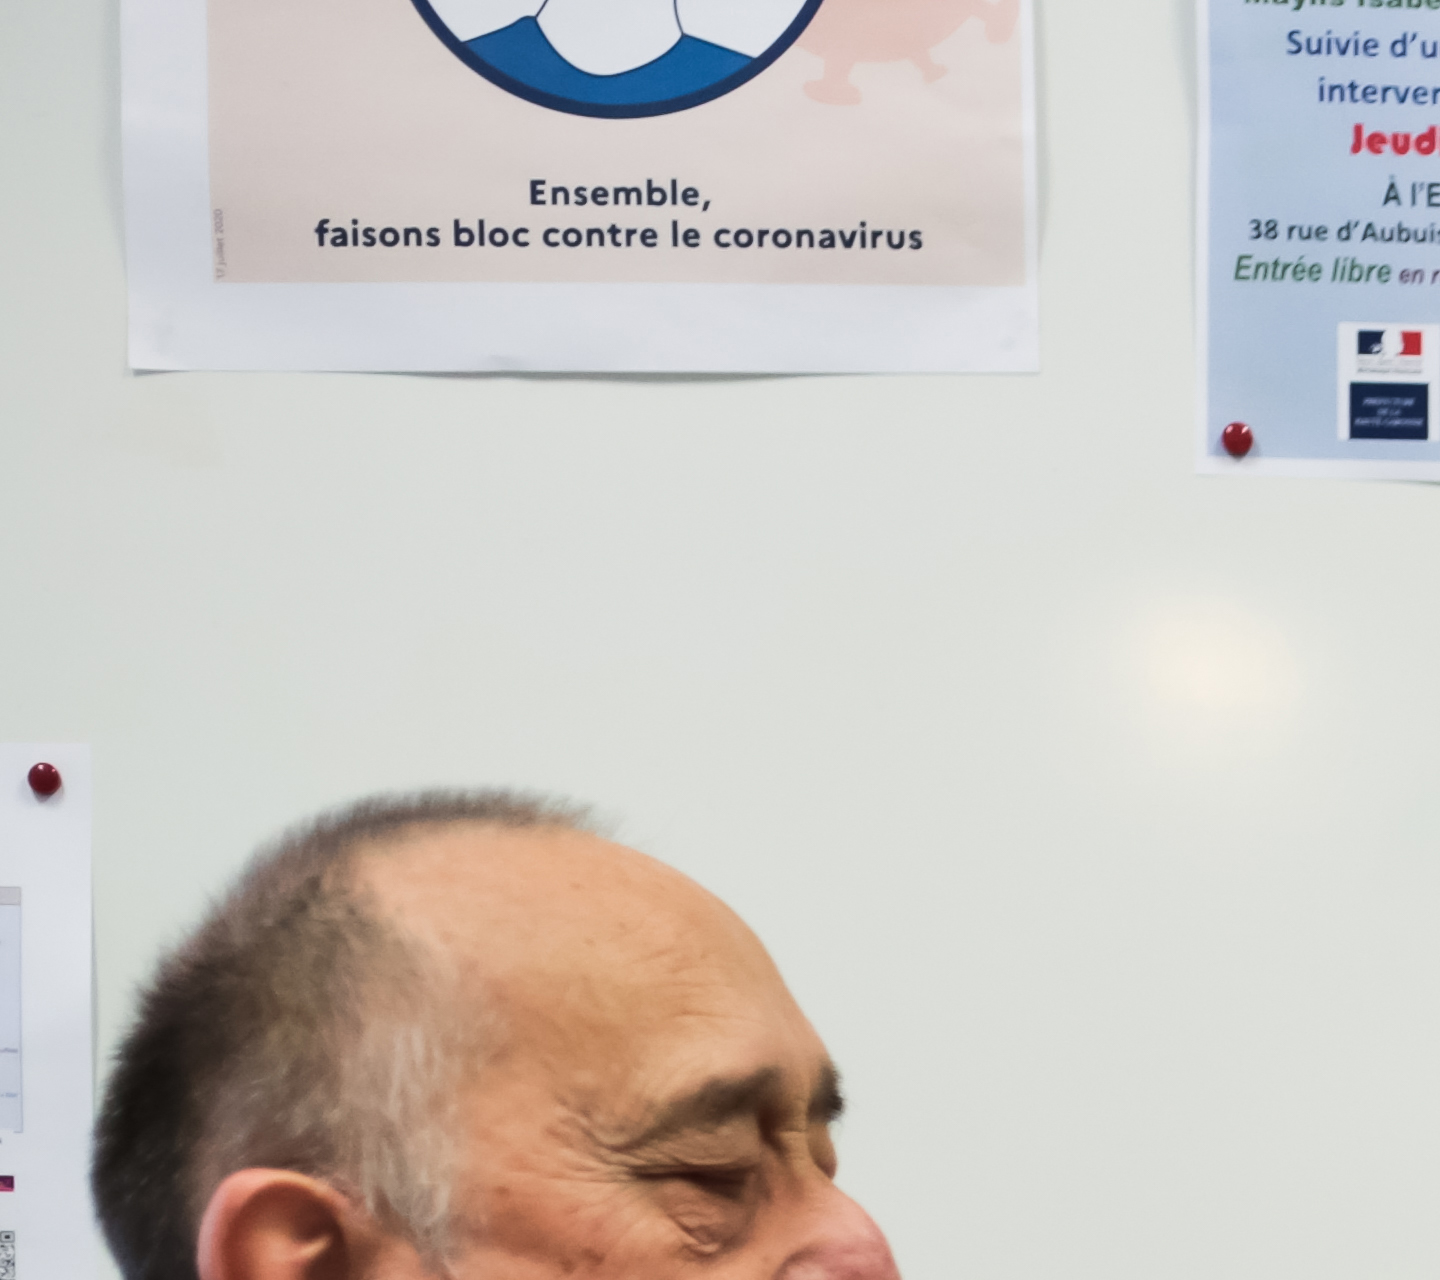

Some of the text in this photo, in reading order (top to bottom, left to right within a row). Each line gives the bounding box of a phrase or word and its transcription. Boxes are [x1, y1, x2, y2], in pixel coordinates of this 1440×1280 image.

[1286, 29, 1380, 58] Suivie
[530, 179, 711, 212] Ensemble,
[1383, 175, 1401, 207] À
[314, 219, 923, 250] faisons bloc contre le coronavirus
[1249, 219, 1278, 240] 38
[1287, 223, 1328, 242] rue
[1233, 254, 1323, 283] Entrée
[1331, 257, 1392, 283] libre
[1399, 266, 1424, 285] en
